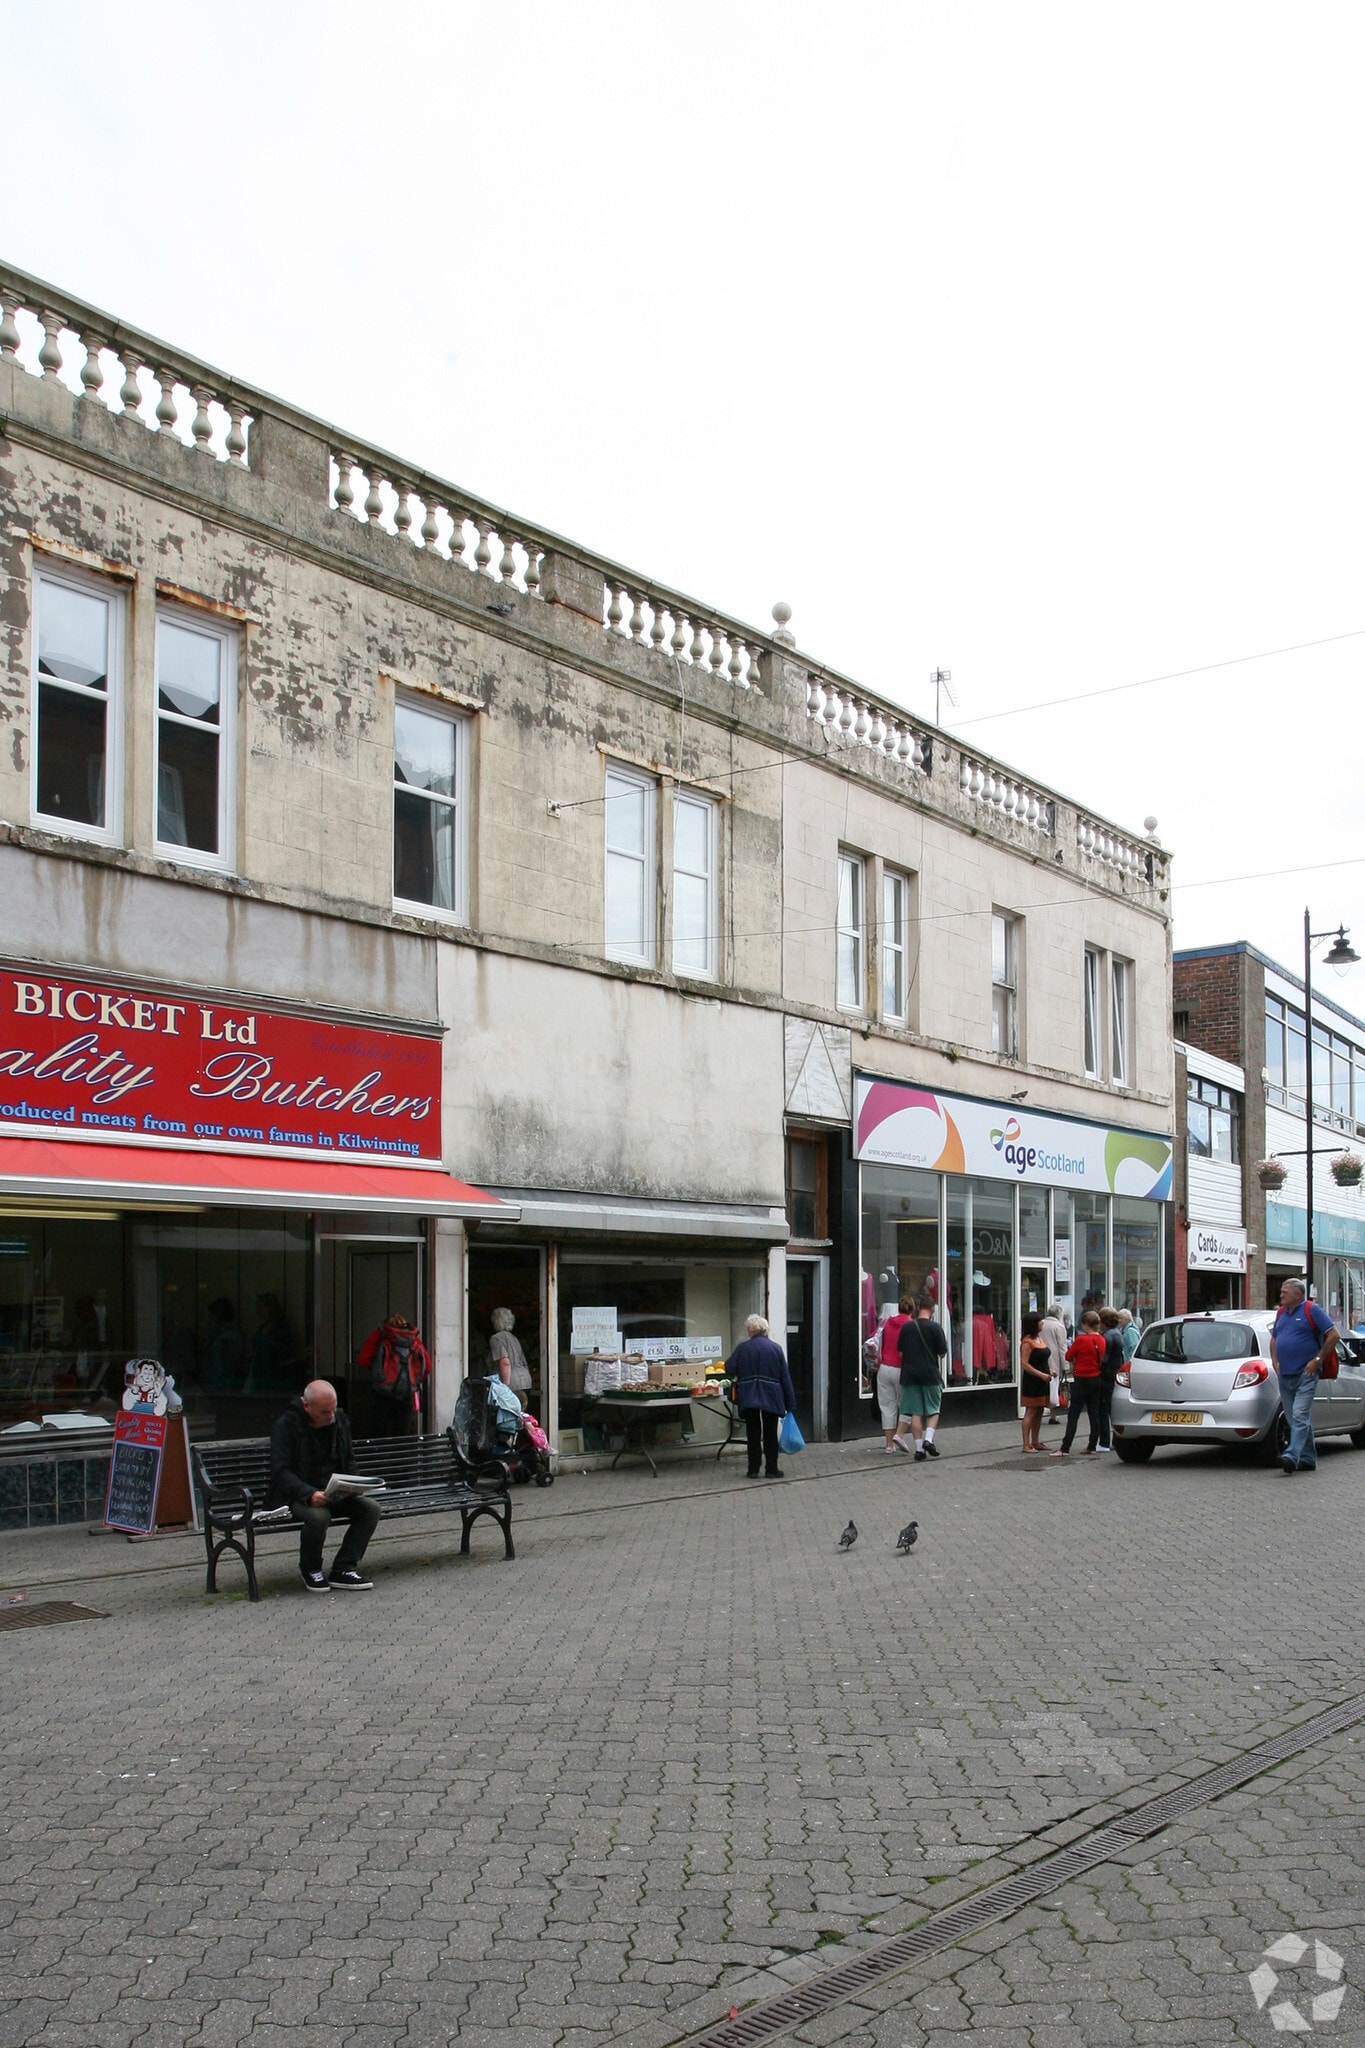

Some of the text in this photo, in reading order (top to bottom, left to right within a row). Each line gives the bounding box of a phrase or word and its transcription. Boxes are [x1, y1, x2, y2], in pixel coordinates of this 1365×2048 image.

[13, 981, 258, 1046] BICKET Ltd
[189, 1050, 434, 1122] Butchers
[0, 1101, 421, 1156] oduced meats from our own farms in Kilwinning
[867, 1148, 929, 1163] www.agescotland.org.uk
[1004, 1144, 1085, 1175] age Scotland
[1198, 1232, 1218, 1253] Cards
[1155, 1413, 1200, 1424] SL60 ZJU
